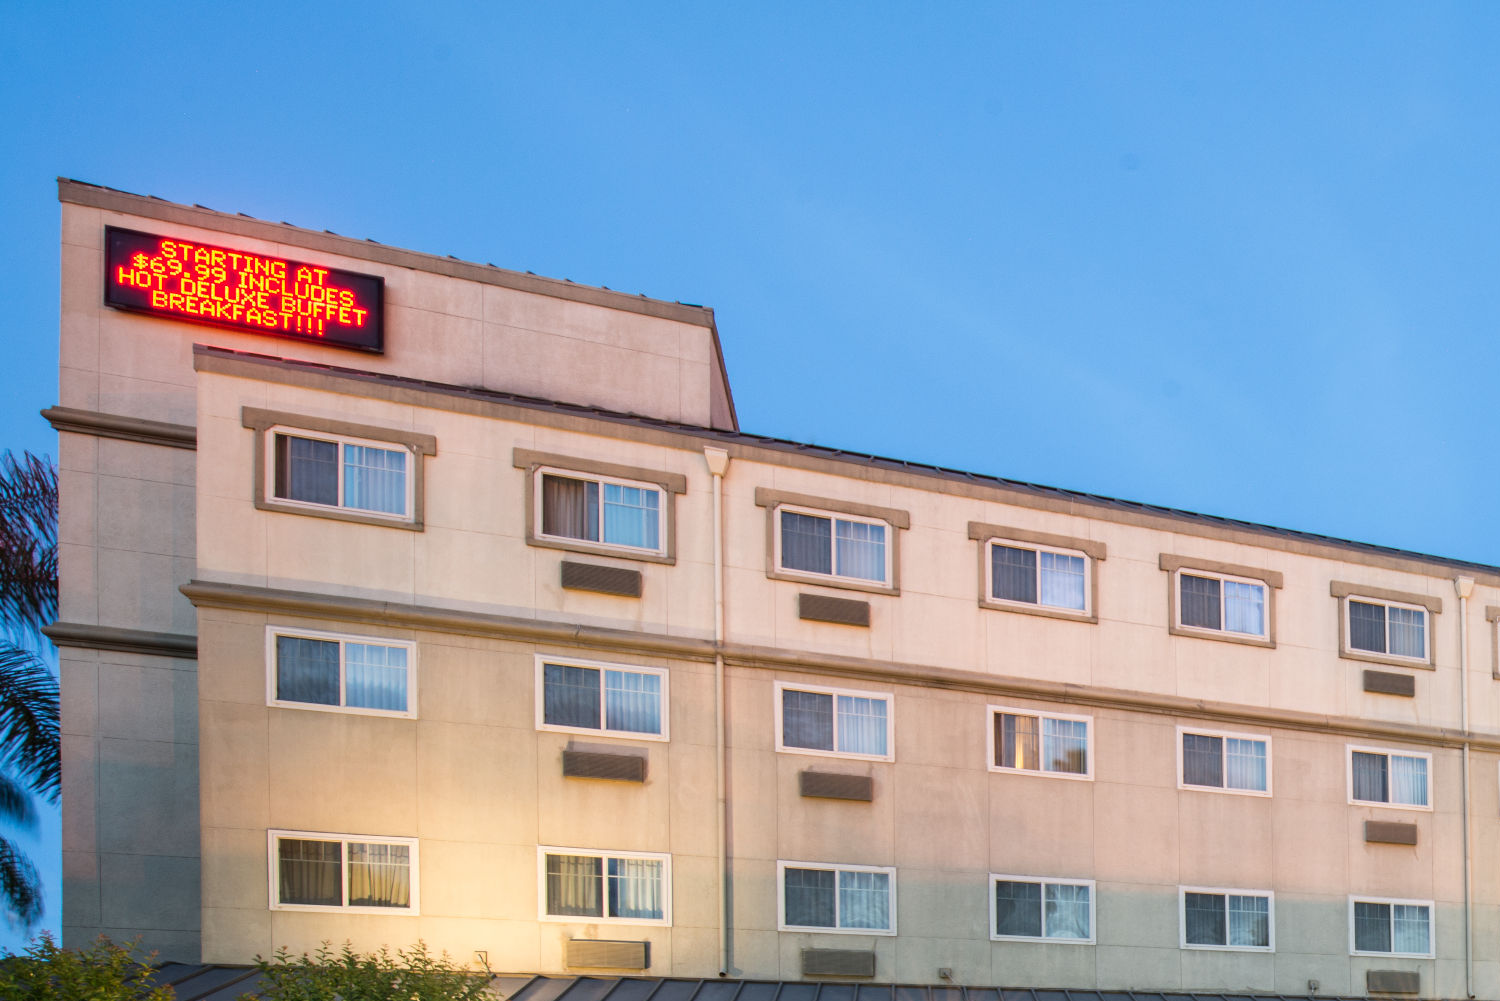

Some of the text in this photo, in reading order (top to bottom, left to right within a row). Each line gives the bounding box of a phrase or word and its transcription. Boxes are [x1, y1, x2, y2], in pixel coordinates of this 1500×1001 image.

[133, 253, 354, 307] $69.99 INCLUDES
[162, 241, 328, 285] STARTING AT
[119, 267, 366, 326] HOT DELUXE BUFFET
[152, 290, 323, 336] BREAKFAST!!!
